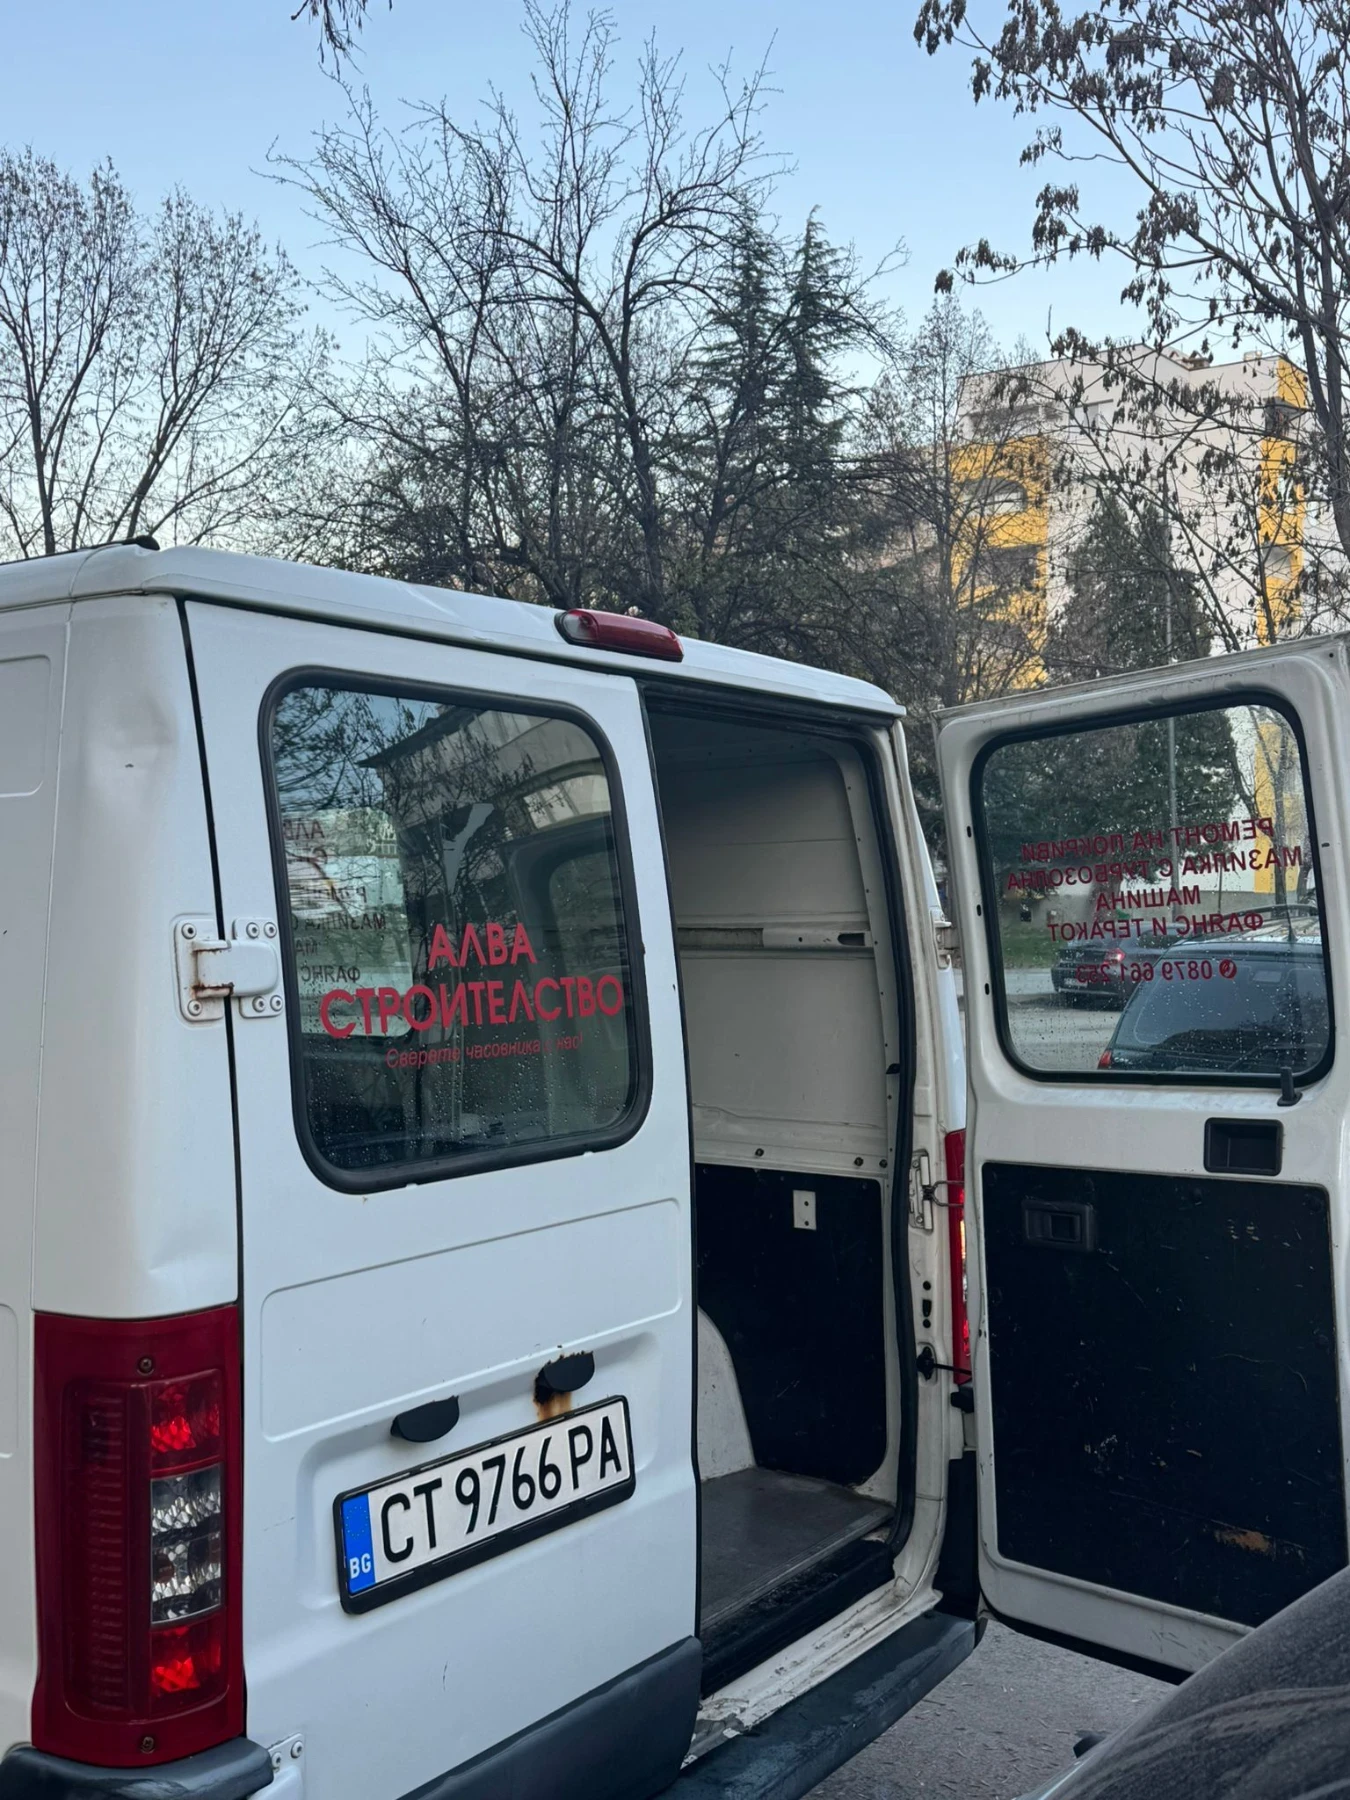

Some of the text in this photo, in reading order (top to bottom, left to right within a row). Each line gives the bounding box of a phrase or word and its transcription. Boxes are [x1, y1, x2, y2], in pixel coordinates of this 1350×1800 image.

[428, 922, 538, 969] АЛВА
[319, 974, 624, 1039] СТРОИТЕЛСТВО
[385, 1047, 461, 1069] Сверете
[465, 1038, 541, 1060] часовника
[455, 1436, 562, 1535] 9766
[350, 1553, 372, 1579] BG
